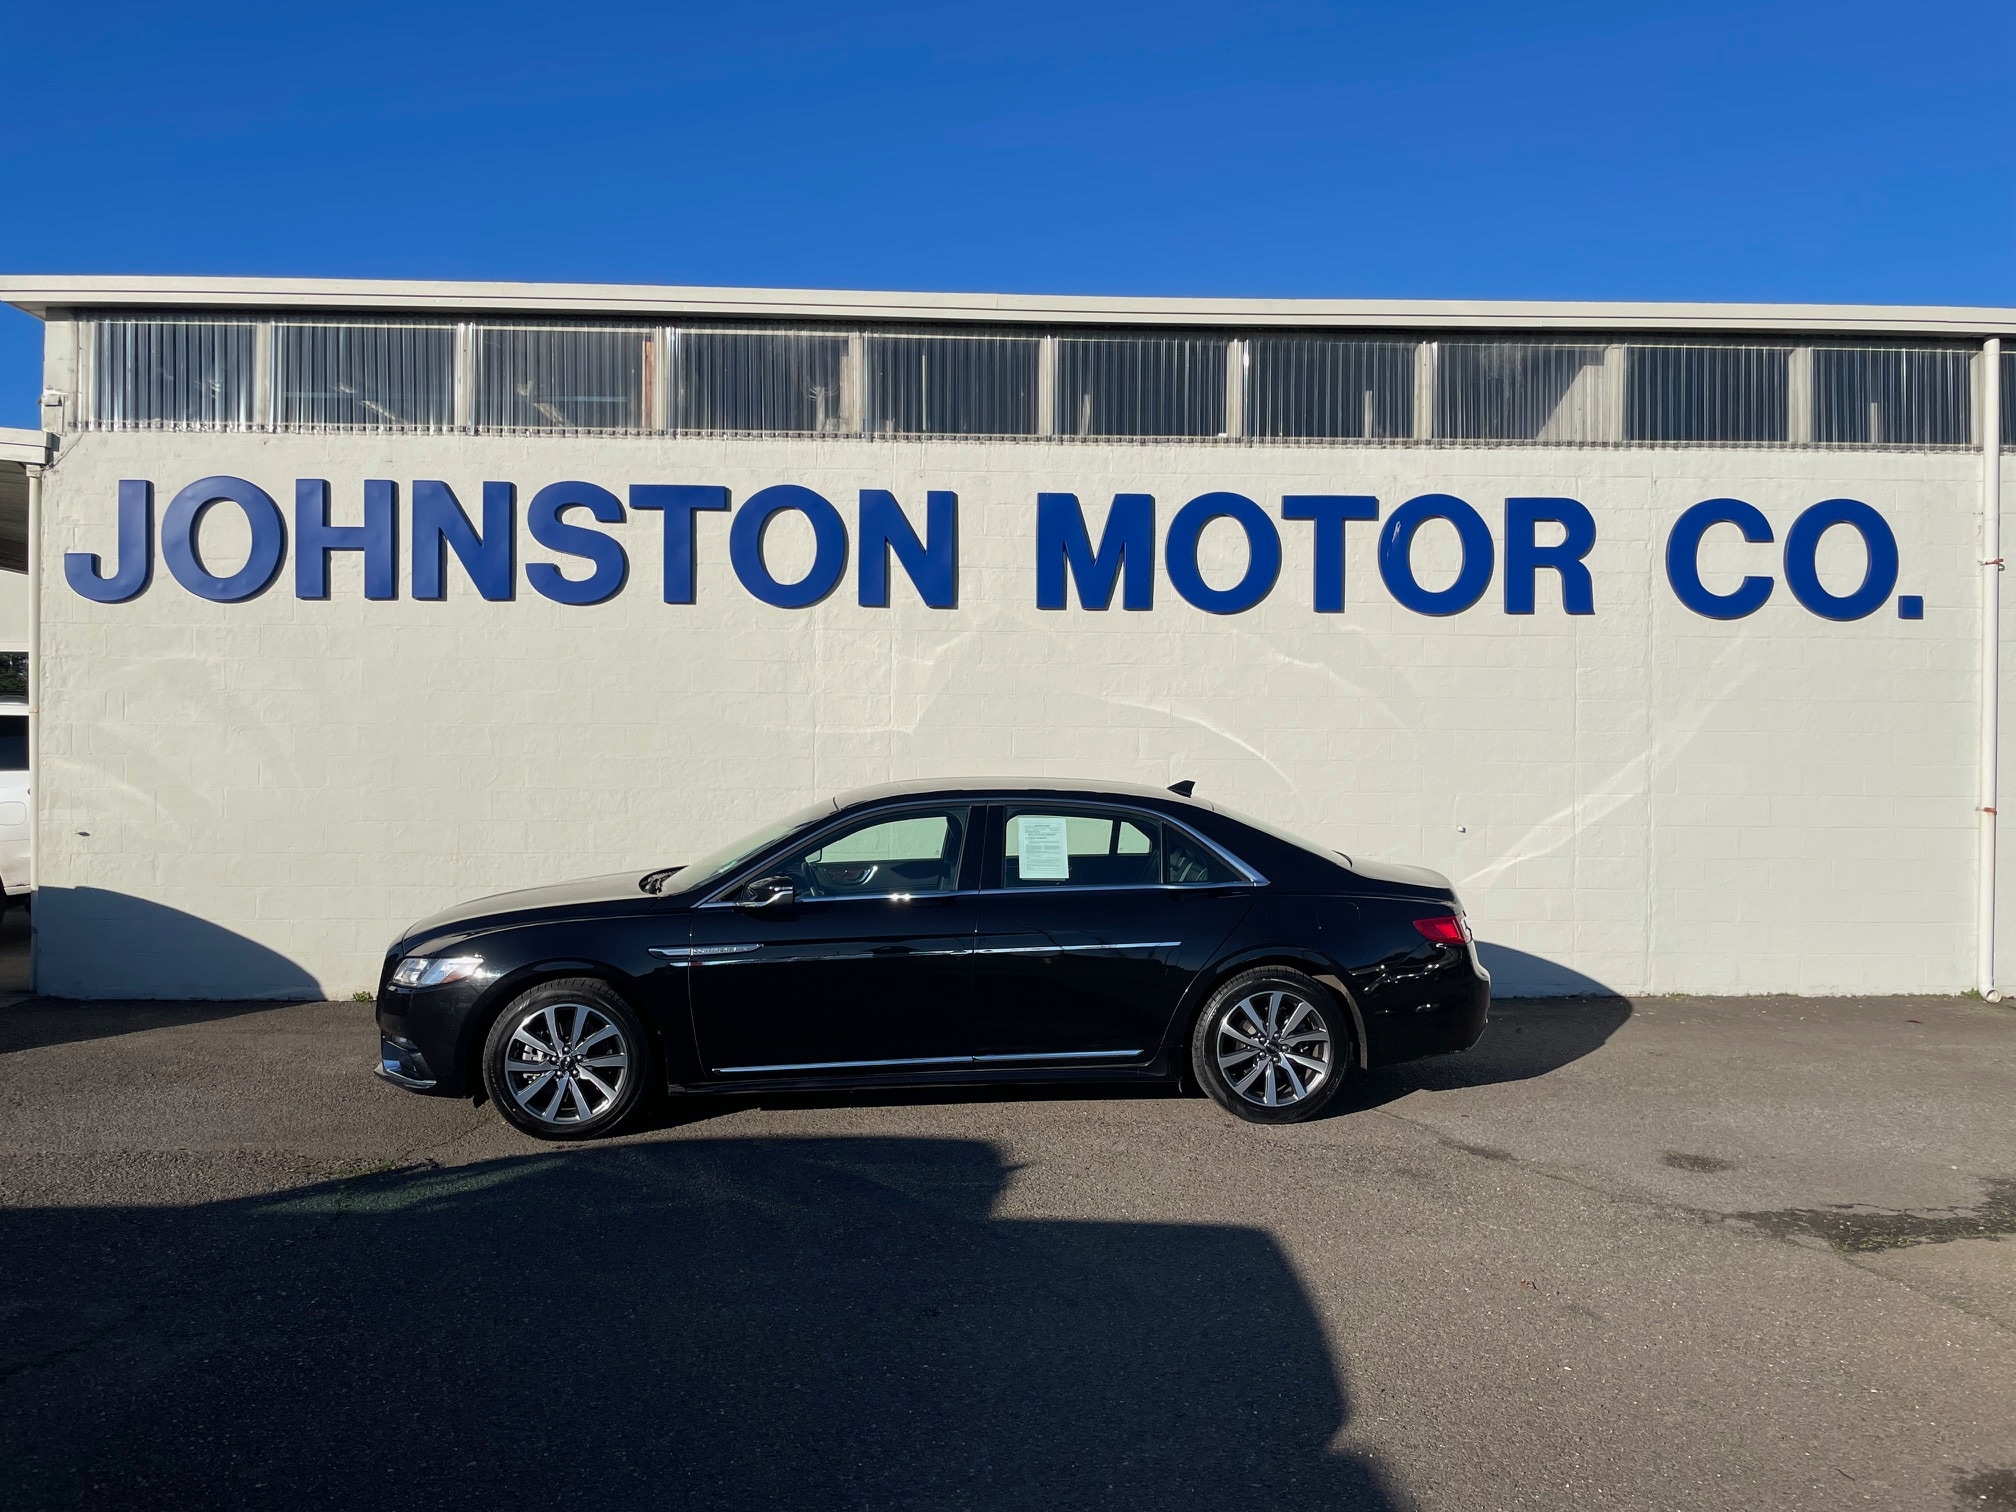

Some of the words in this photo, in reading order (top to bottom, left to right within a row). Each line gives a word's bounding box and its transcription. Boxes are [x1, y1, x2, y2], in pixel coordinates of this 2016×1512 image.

[64, 475, 958, 608] JOHNSTON
[1036, 491, 1596, 616] MOTOR
[1666, 497, 1924, 620] CO.
